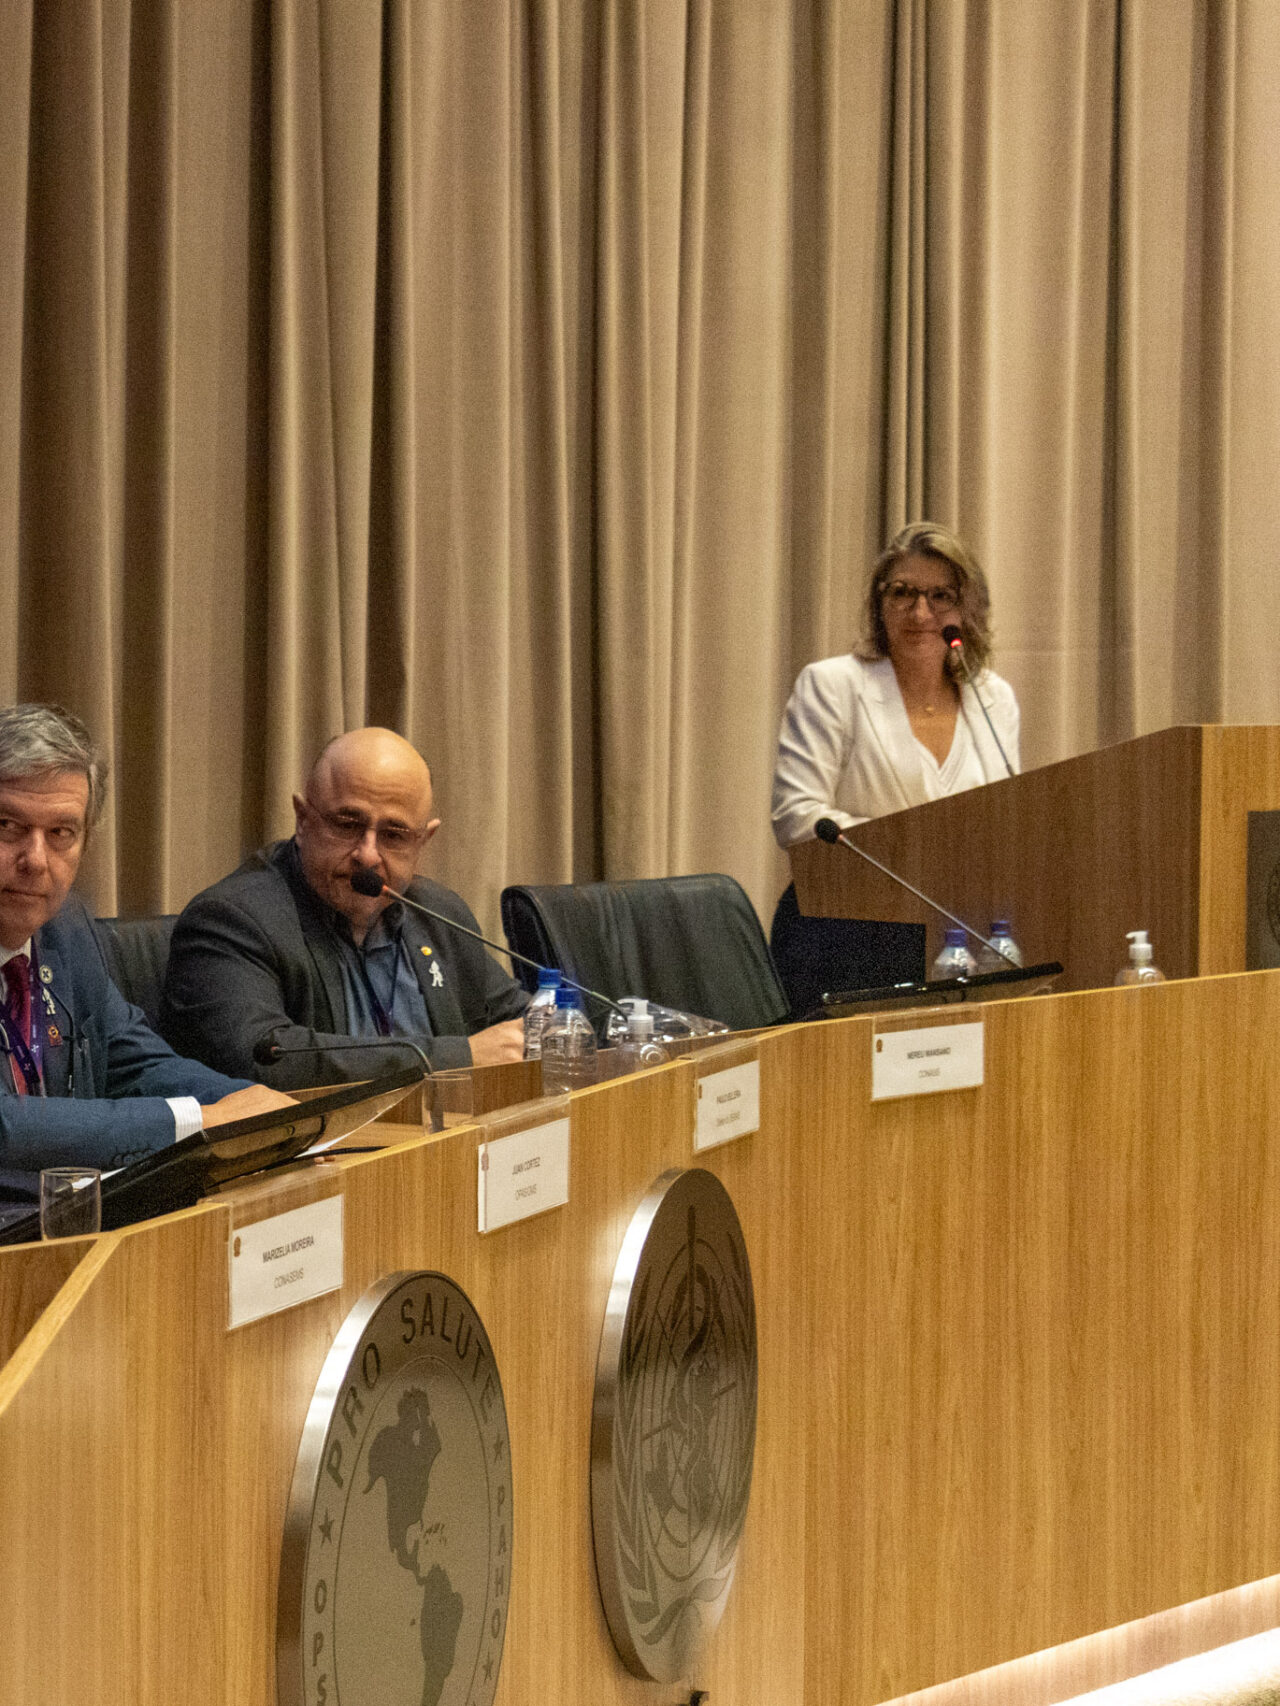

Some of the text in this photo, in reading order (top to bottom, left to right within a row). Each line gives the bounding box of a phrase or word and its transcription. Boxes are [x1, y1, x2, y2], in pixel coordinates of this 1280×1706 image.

[291, 1235, 315, 1253] MOREIRA
[326, 1292, 498, 1490] PRO SALUTE
[490, 1484, 507, 1641] PAHO
